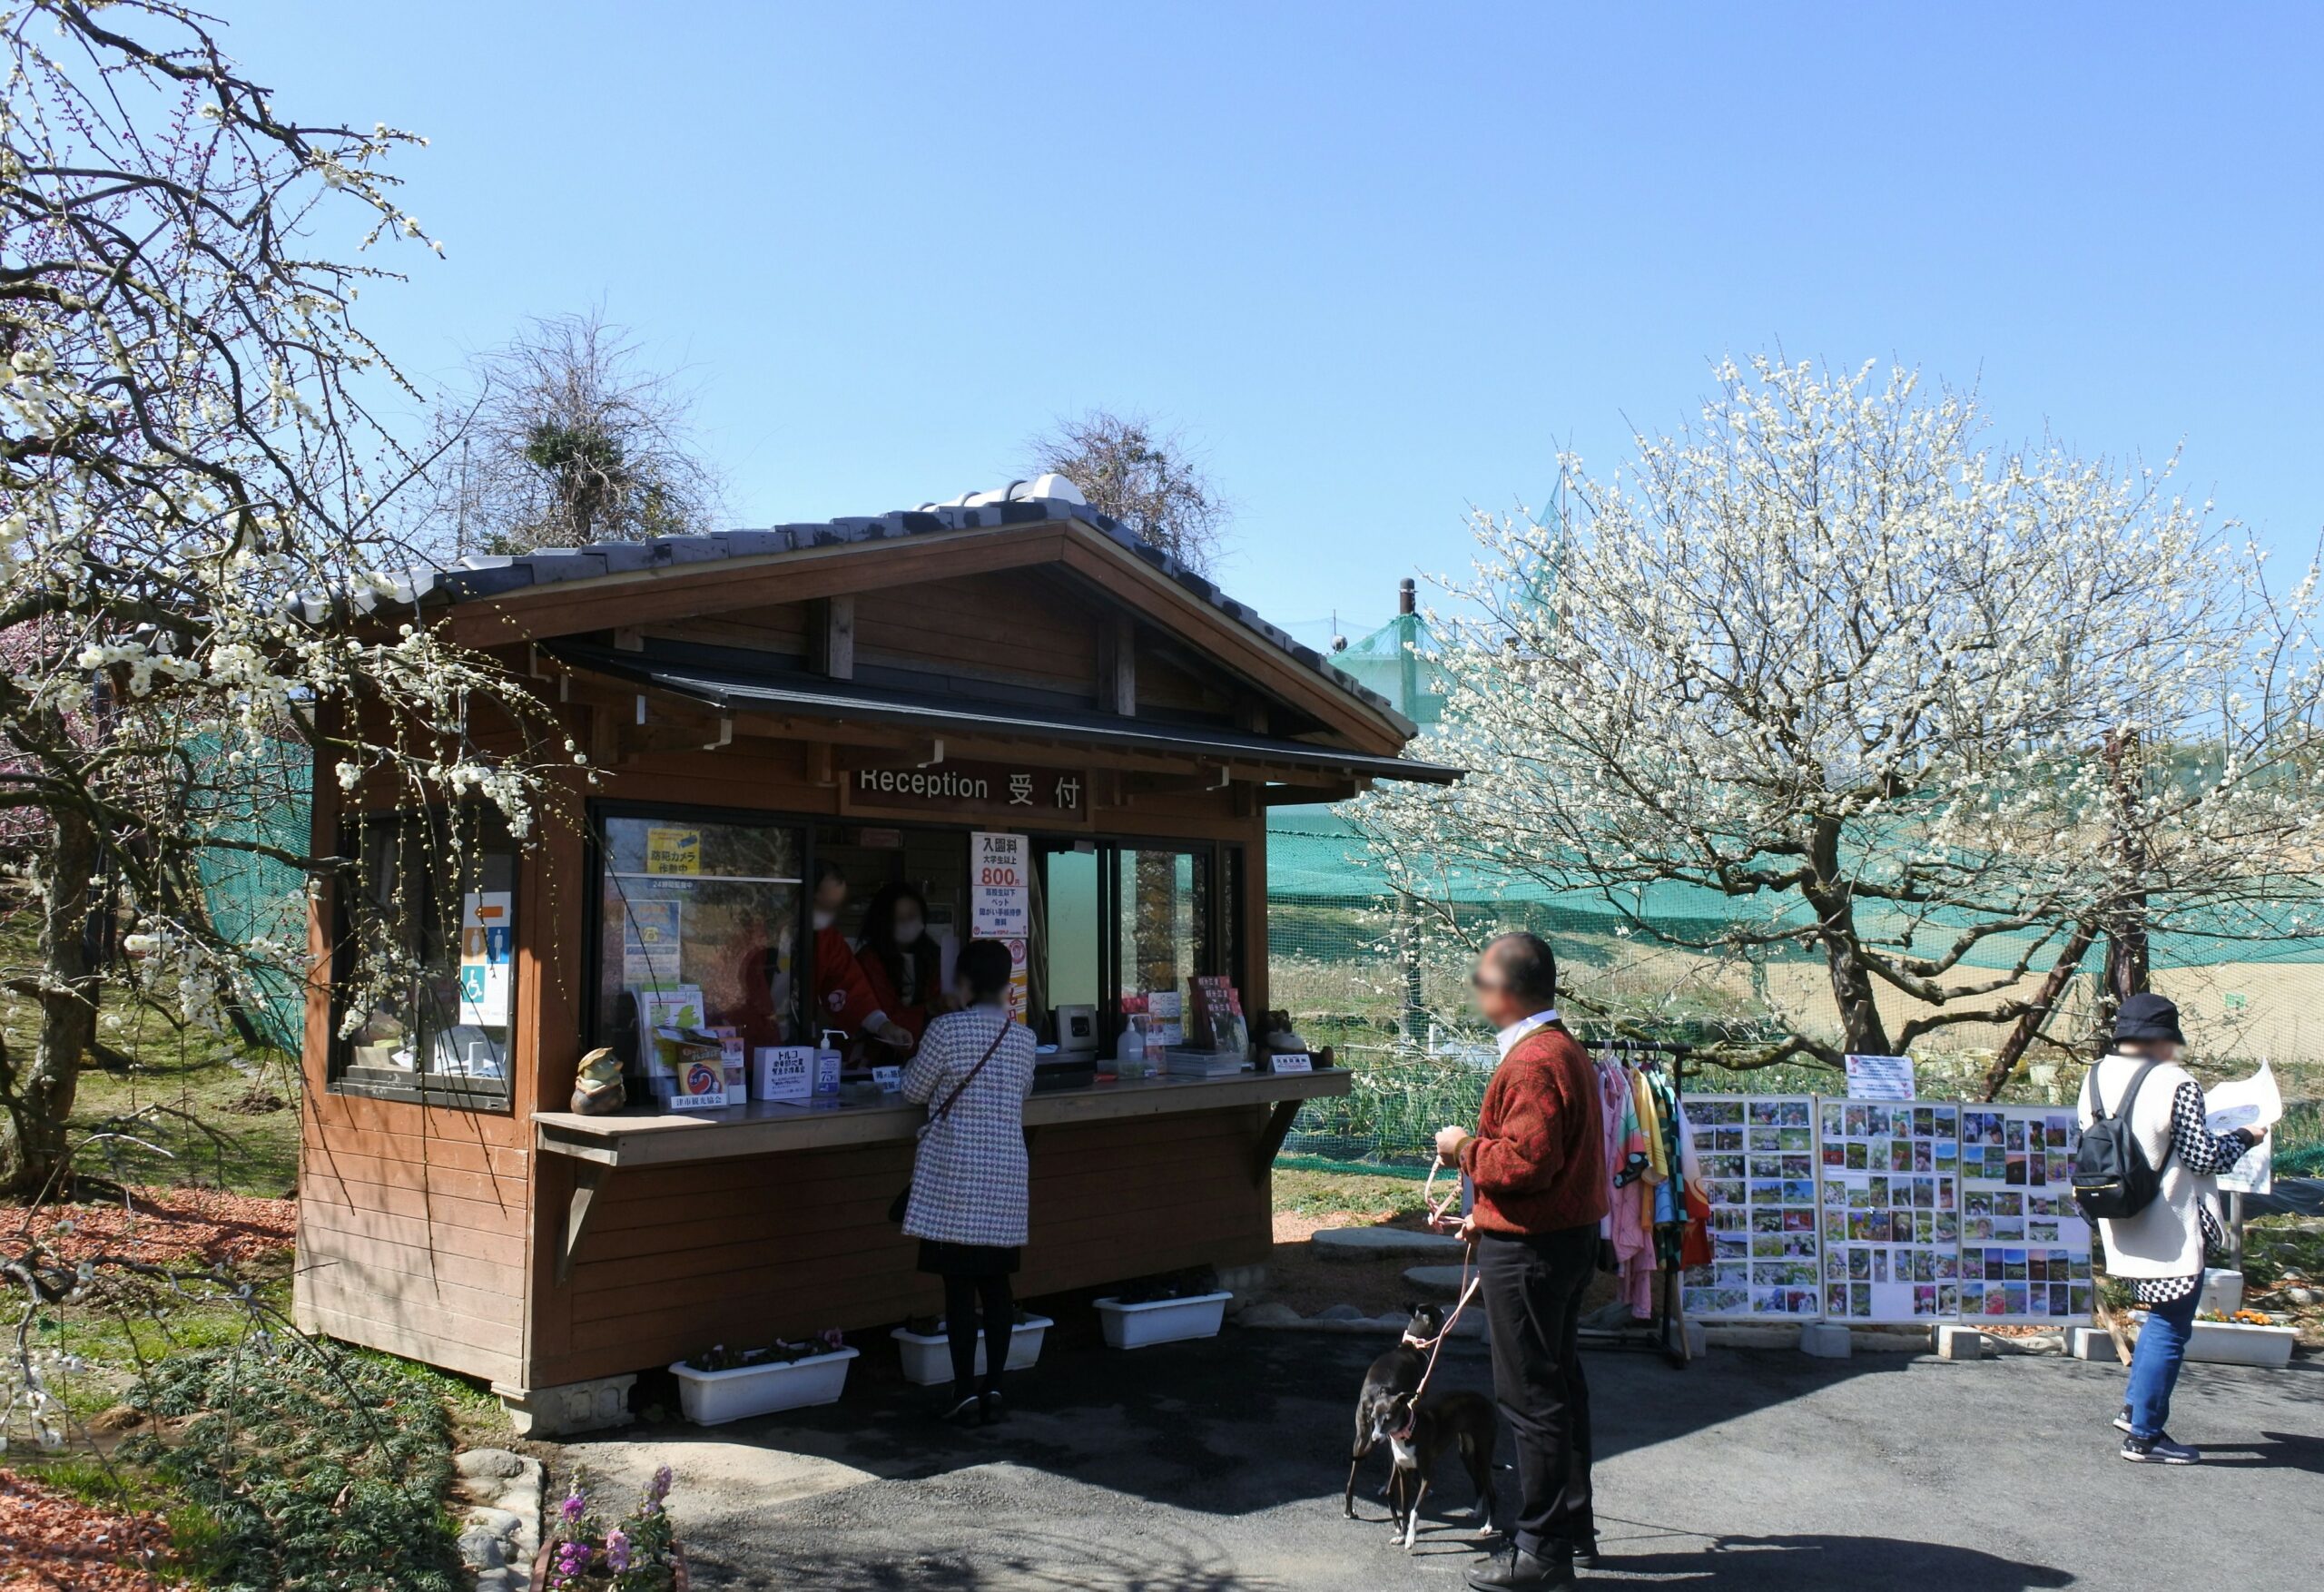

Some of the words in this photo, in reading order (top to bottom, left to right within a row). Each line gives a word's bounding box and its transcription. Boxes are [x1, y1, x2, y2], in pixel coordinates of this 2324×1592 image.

[860, 769, 988, 799] Reception
[982, 837, 1018, 854] 入園料
[650, 850, 696, 862] 防犯カメラ
[983, 855, 1018, 865] 大学生以上
[985, 888, 1017, 897] 高校生以下
[990, 898, 1009, 907] ペット
[778, 1049, 798, 1061] トルコ
[675, 1096, 723, 1106] 津市観光協会
